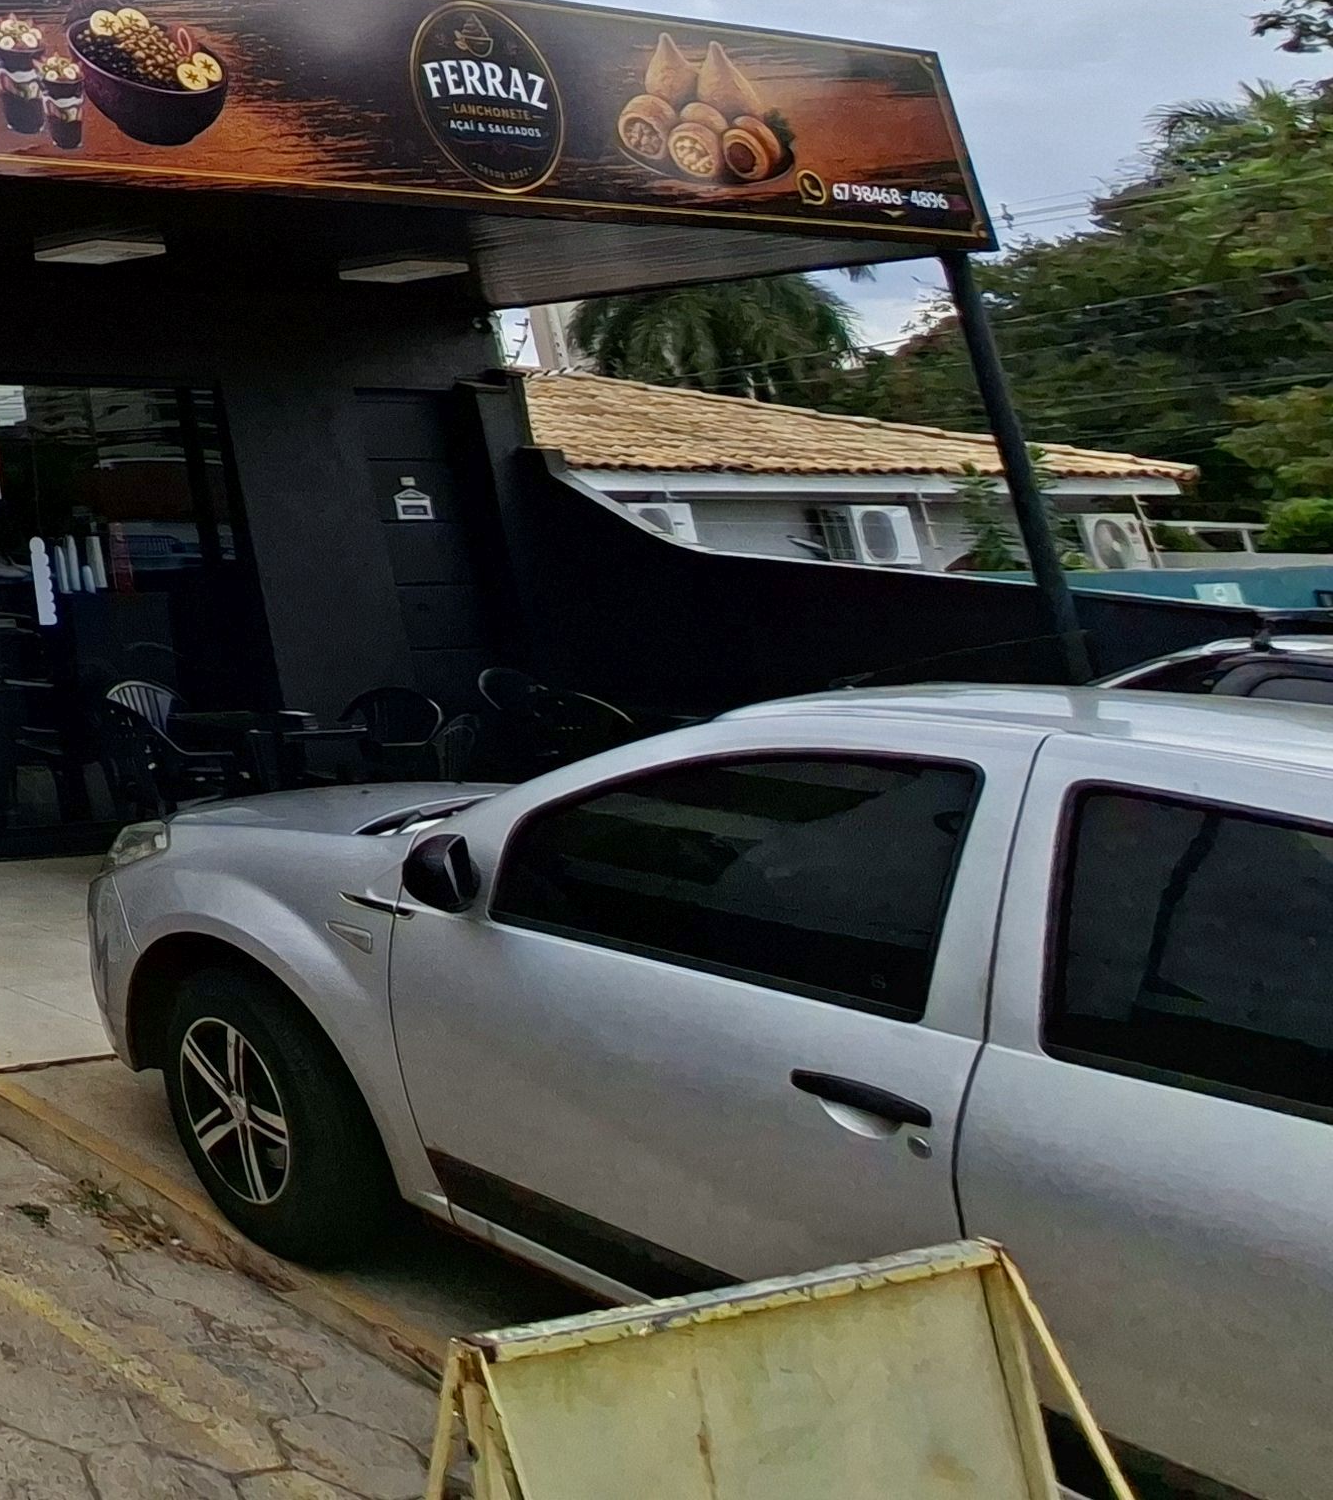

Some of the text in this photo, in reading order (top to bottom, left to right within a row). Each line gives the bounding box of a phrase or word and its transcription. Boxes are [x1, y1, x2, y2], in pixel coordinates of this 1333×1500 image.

[422, 60, 548, 110] FERRAZ
[453, 102, 530, 120] LANCHONETE
[450, 119, 542, 138] AÇAÍ & SALGADOS
[833, 183, 949, 209] 67 98468-4896
